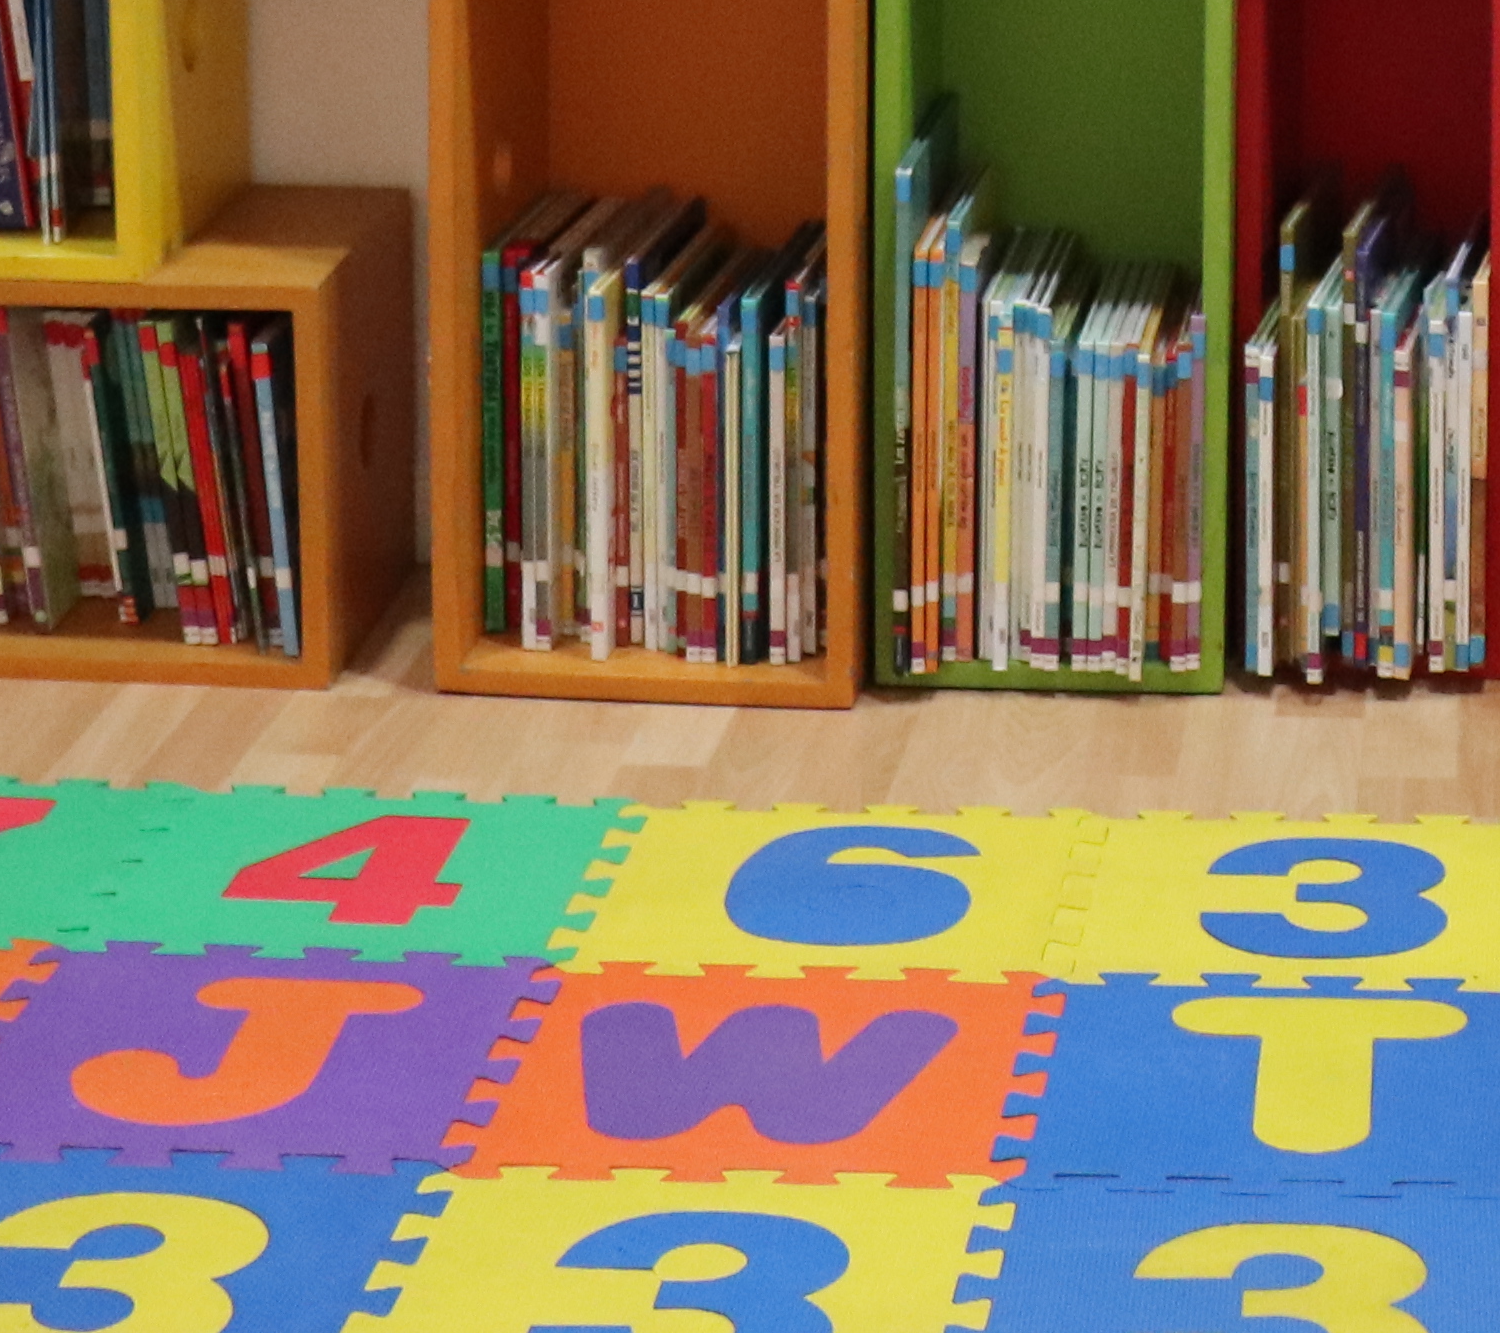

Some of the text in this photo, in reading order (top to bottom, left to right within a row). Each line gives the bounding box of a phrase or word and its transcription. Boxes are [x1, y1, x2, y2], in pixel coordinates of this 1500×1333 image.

[220, 814, 472, 924] 4
[722, 825, 982, 947] 6
[1197, 835, 1449, 959] 3
[70, 976, 425, 1127] J
[579, 1002, 960, 1145] W
[1170, 996, 1469, 1155] T
[555, 1209, 852, 1333] 3
